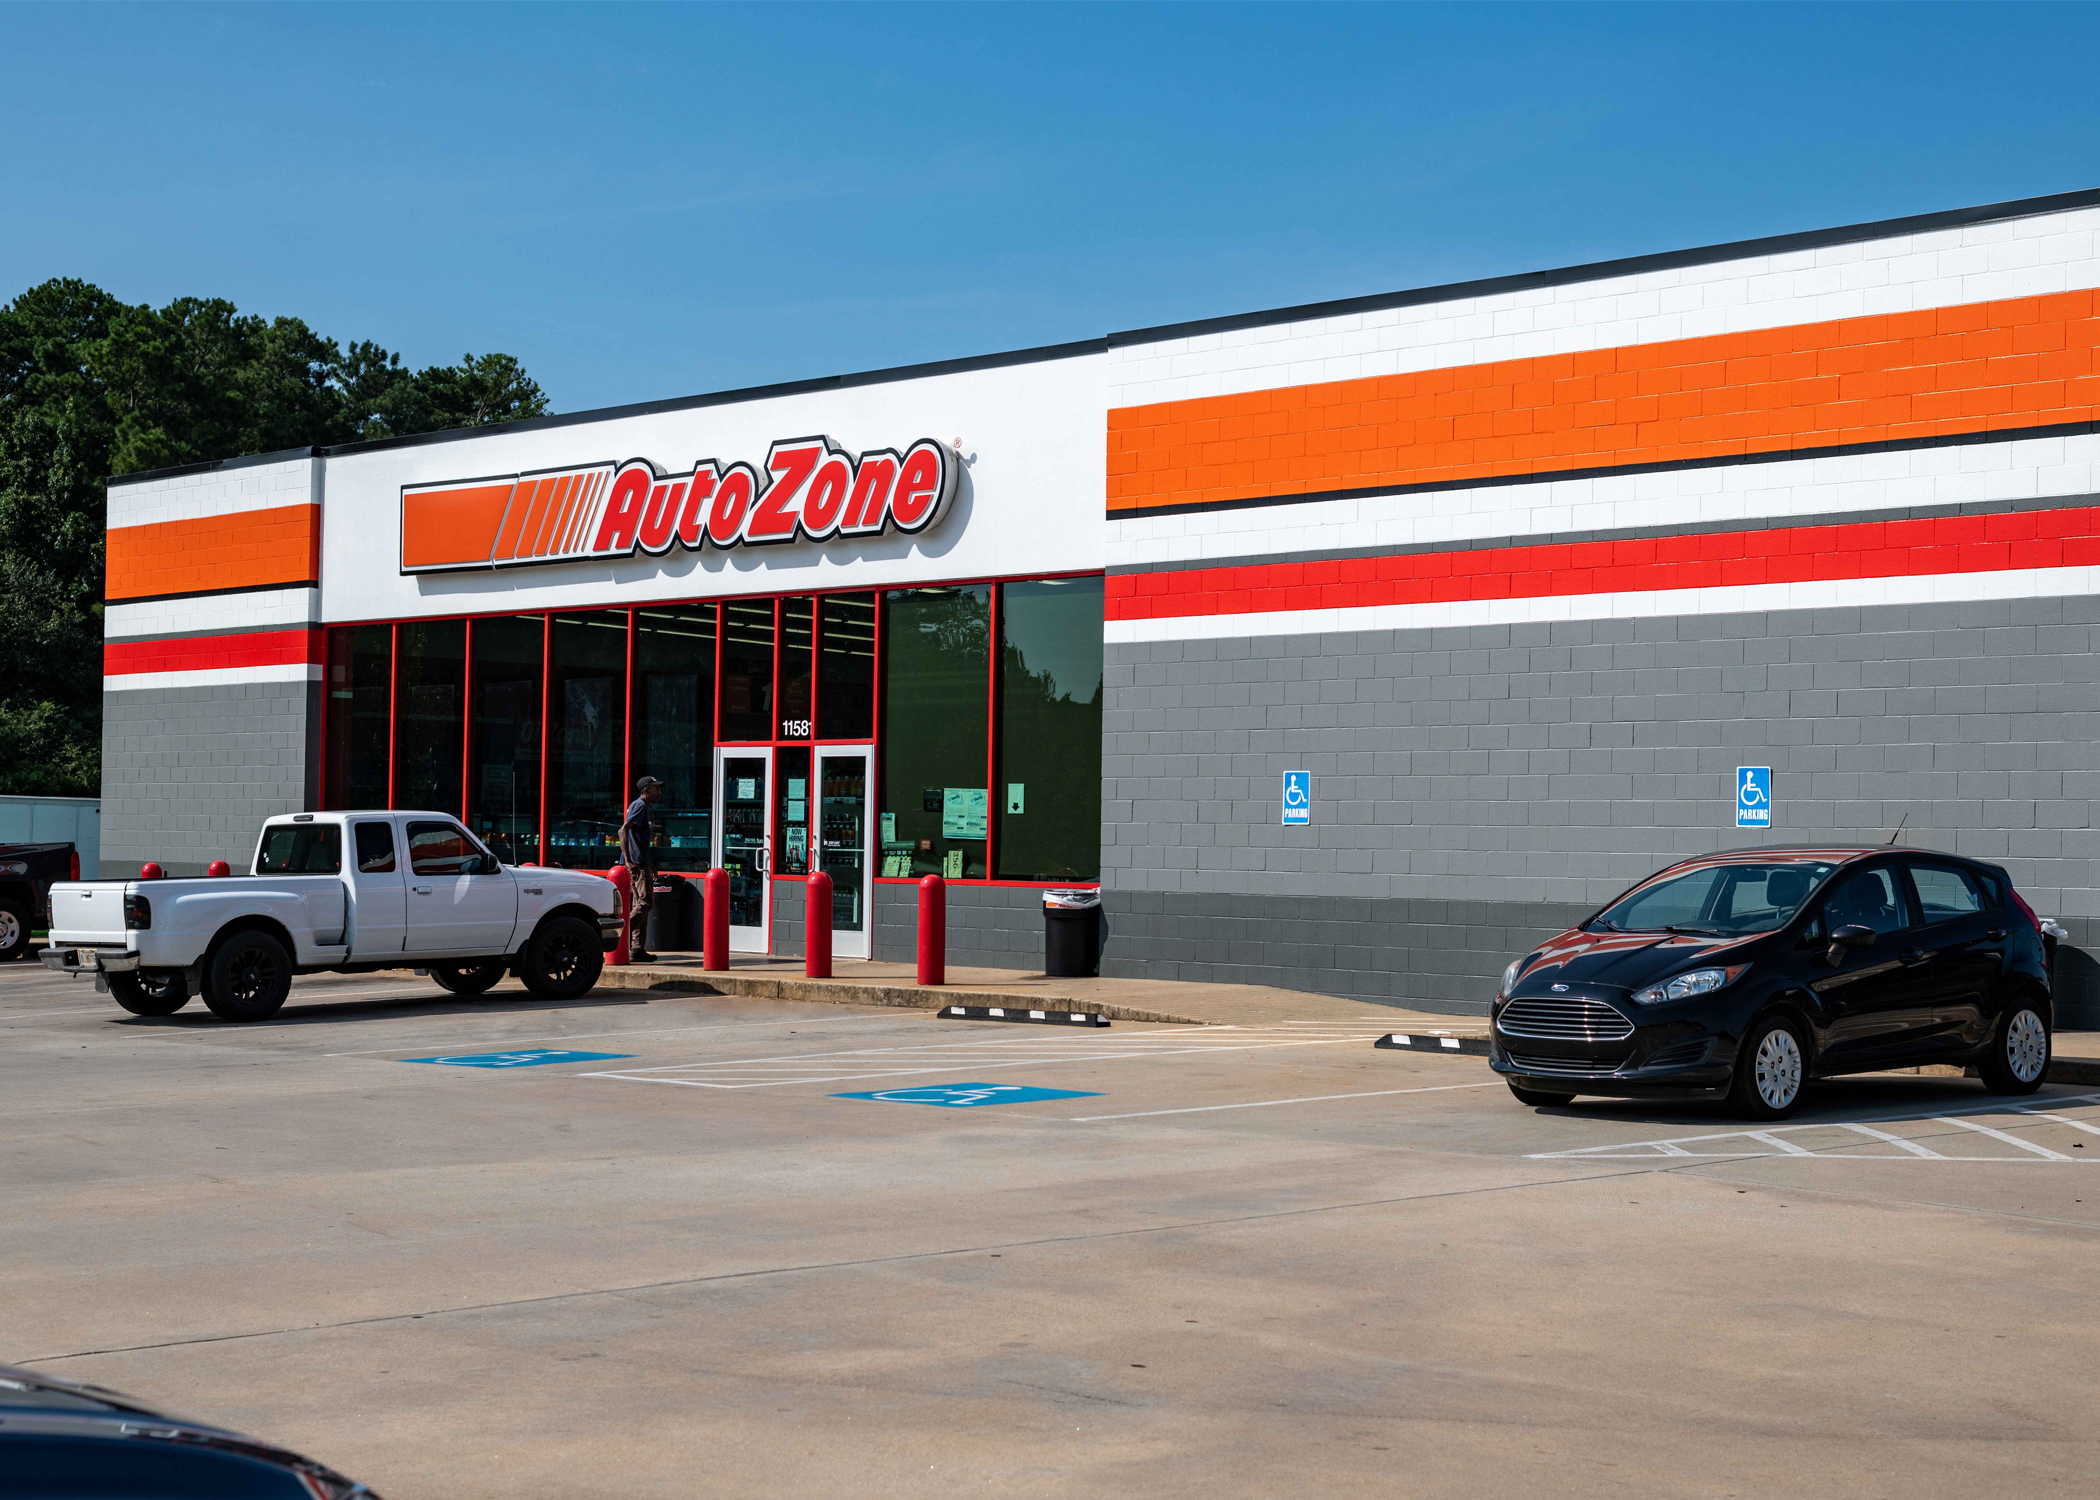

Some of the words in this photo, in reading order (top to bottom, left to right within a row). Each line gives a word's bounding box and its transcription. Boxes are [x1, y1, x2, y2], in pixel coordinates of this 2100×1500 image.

[593, 447, 937, 551] AutoZone
[1285, 808, 1308, 818] PARKING
[1739, 809, 1768, 819] PARKING
